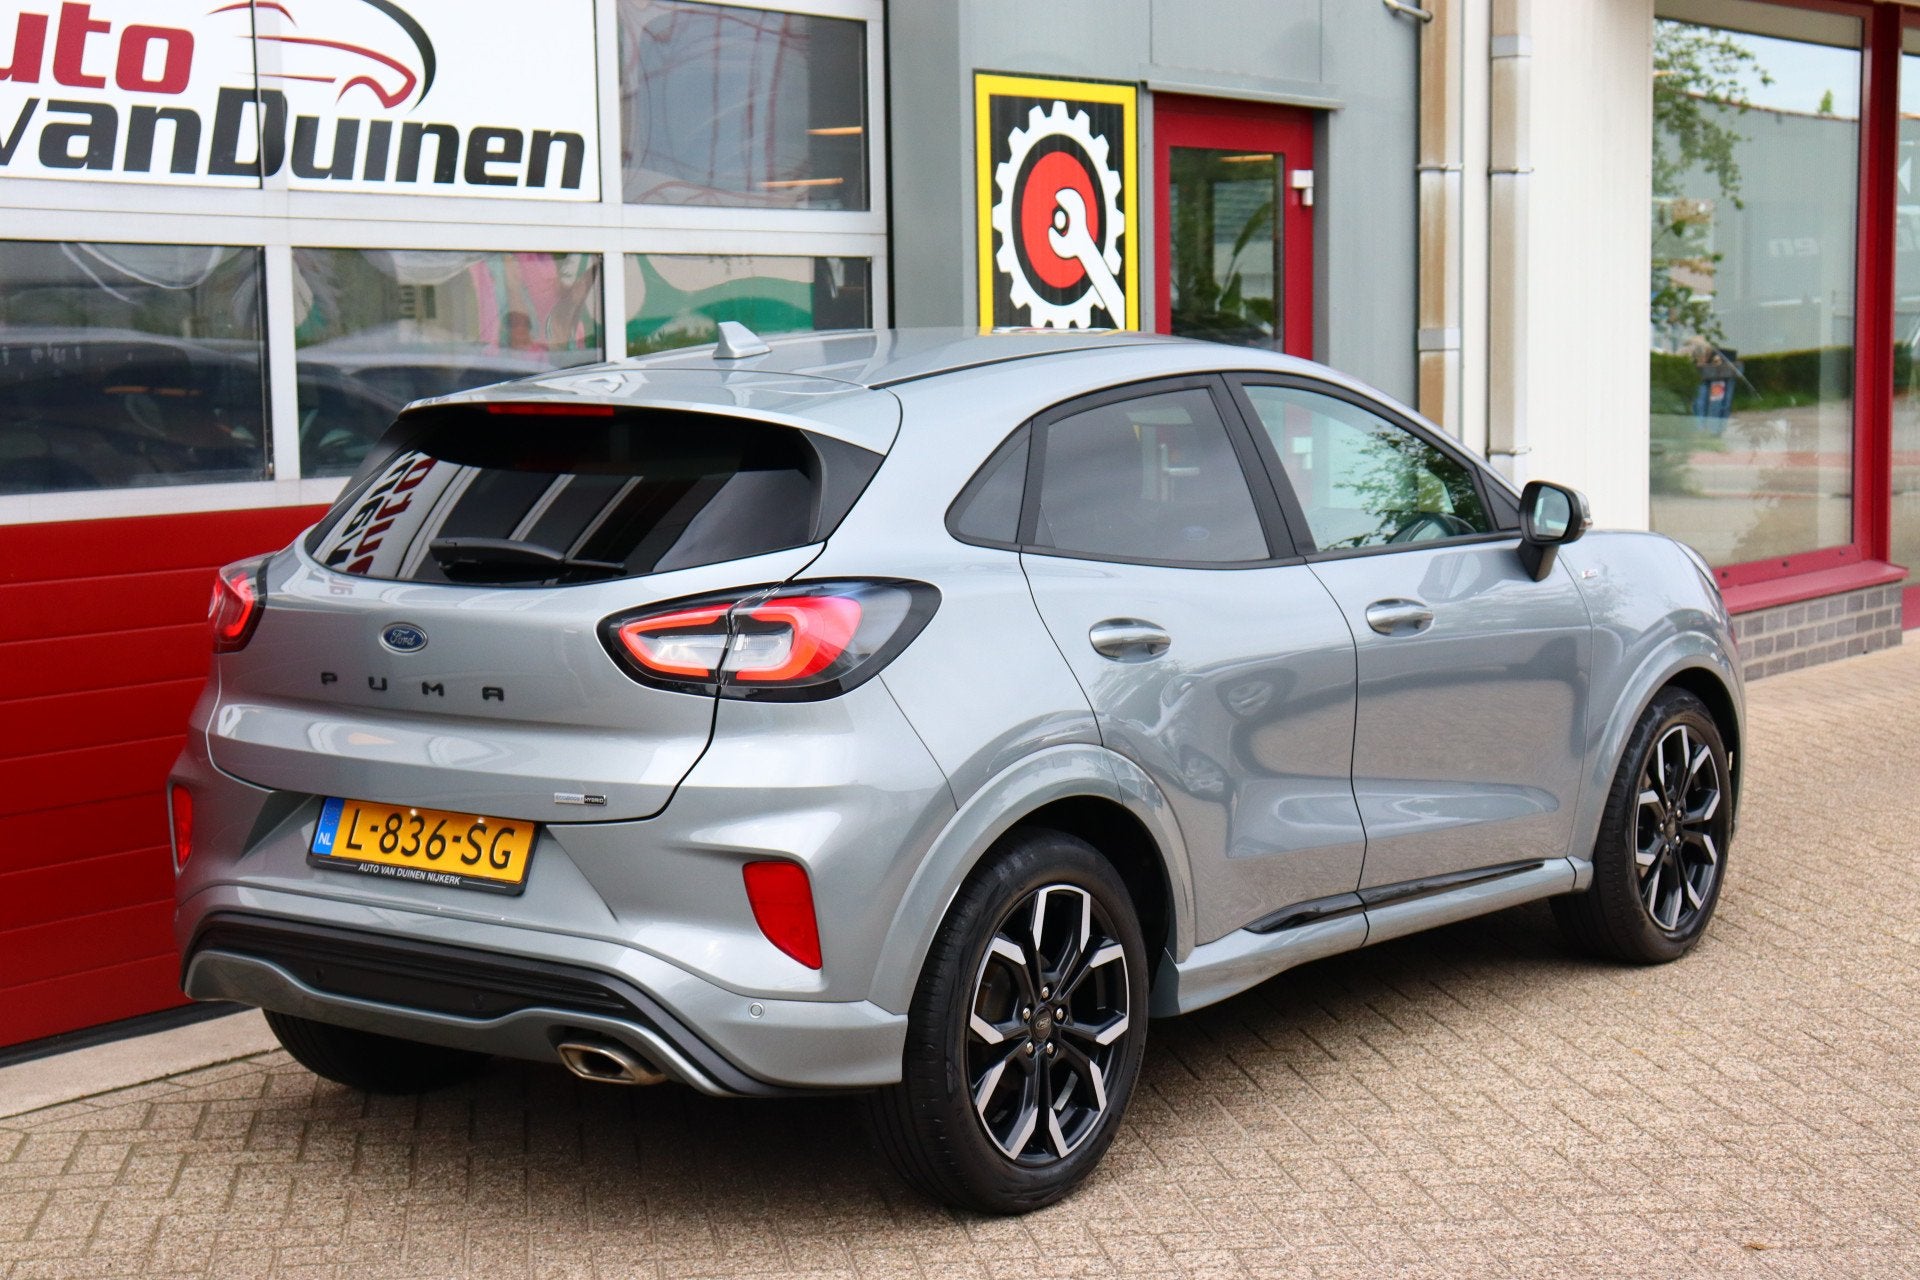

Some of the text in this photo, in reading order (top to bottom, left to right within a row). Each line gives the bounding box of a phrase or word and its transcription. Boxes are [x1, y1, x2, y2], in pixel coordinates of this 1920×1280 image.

[389, 628, 416, 646] Ford
[321, 672, 504, 701] PUMA
[318, 832, 332, 846] NL
[346, 808, 516, 870] L-836-SG
[358, 863, 461, 886] AUTO VAN DUINEN NIJKERK
